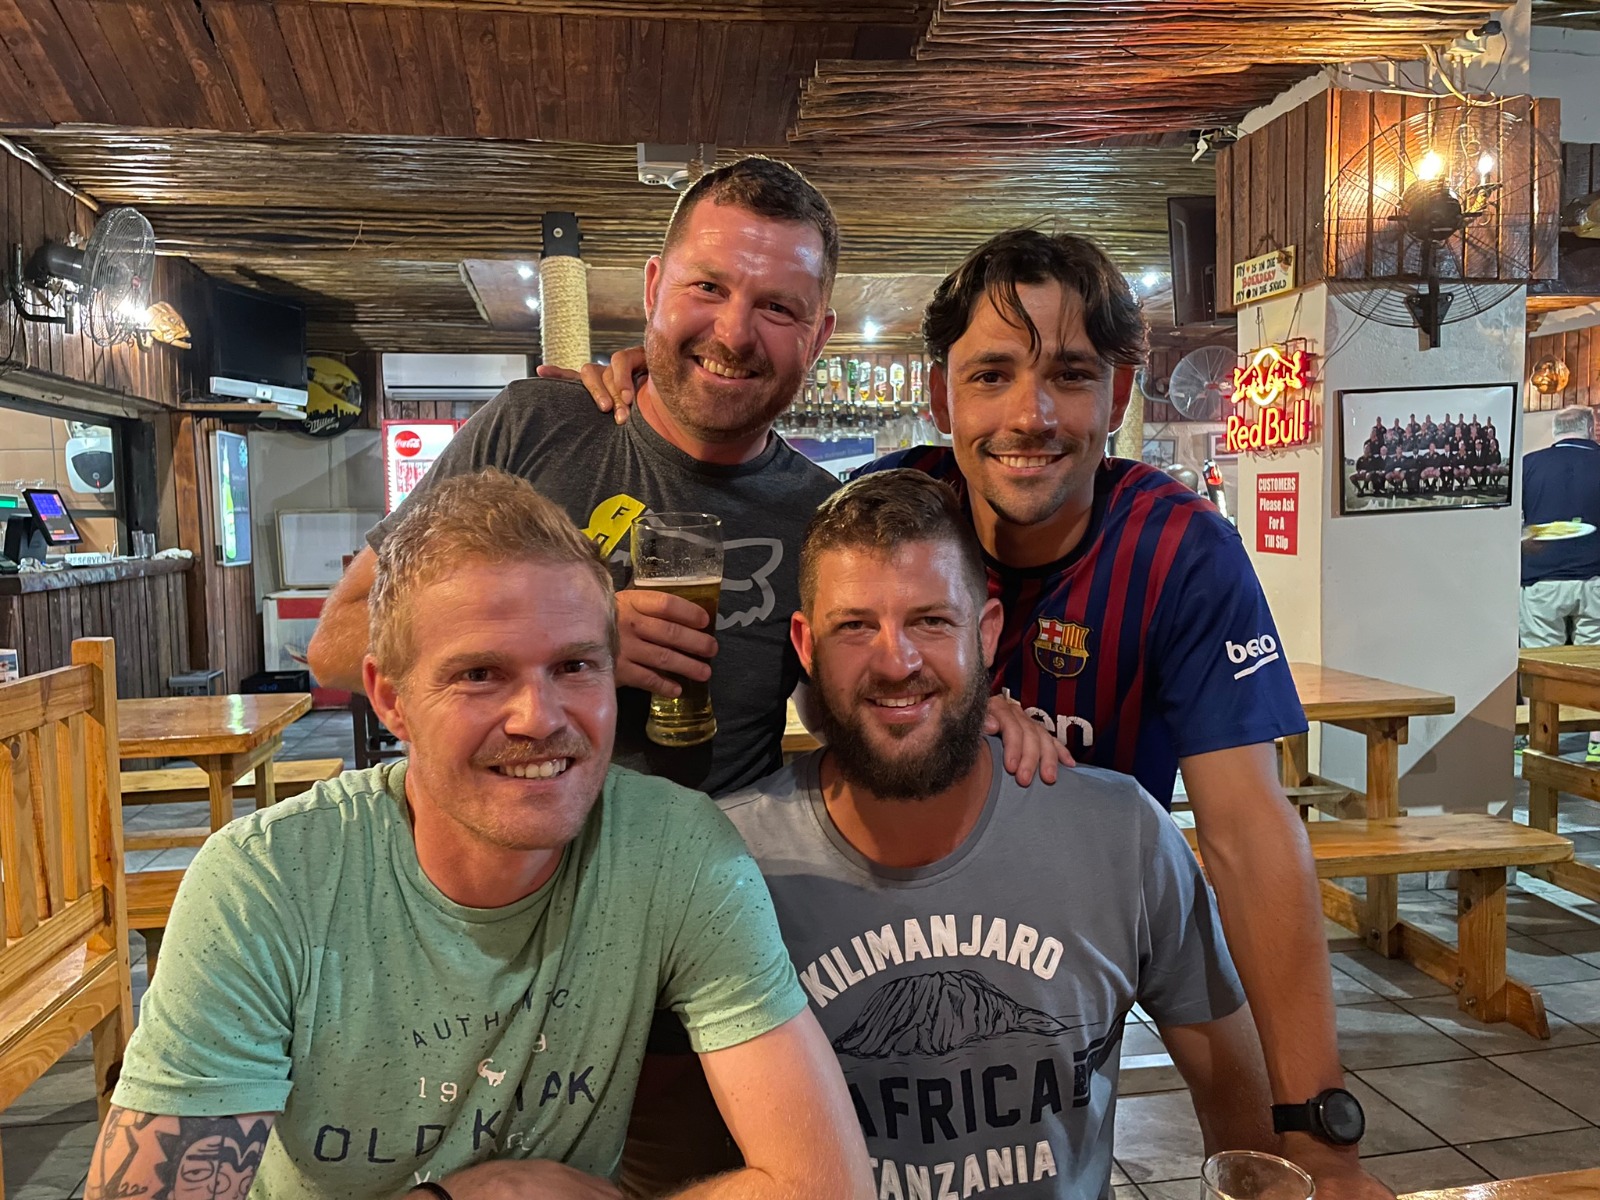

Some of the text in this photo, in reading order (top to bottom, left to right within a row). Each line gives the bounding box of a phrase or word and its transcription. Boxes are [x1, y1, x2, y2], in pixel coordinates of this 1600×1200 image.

[1258, 477, 1296, 492] CUSTOMERS
[1259, 498, 1295, 512] Please Ask
[1268, 516, 1285, 530] For A
[1264, 534, 1289, 550] Till Slip
[1225, 634, 1277, 664] beo
[799, 914, 1065, 1009] KILIMANJARO
[313, 1123, 447, 1164] OLD
